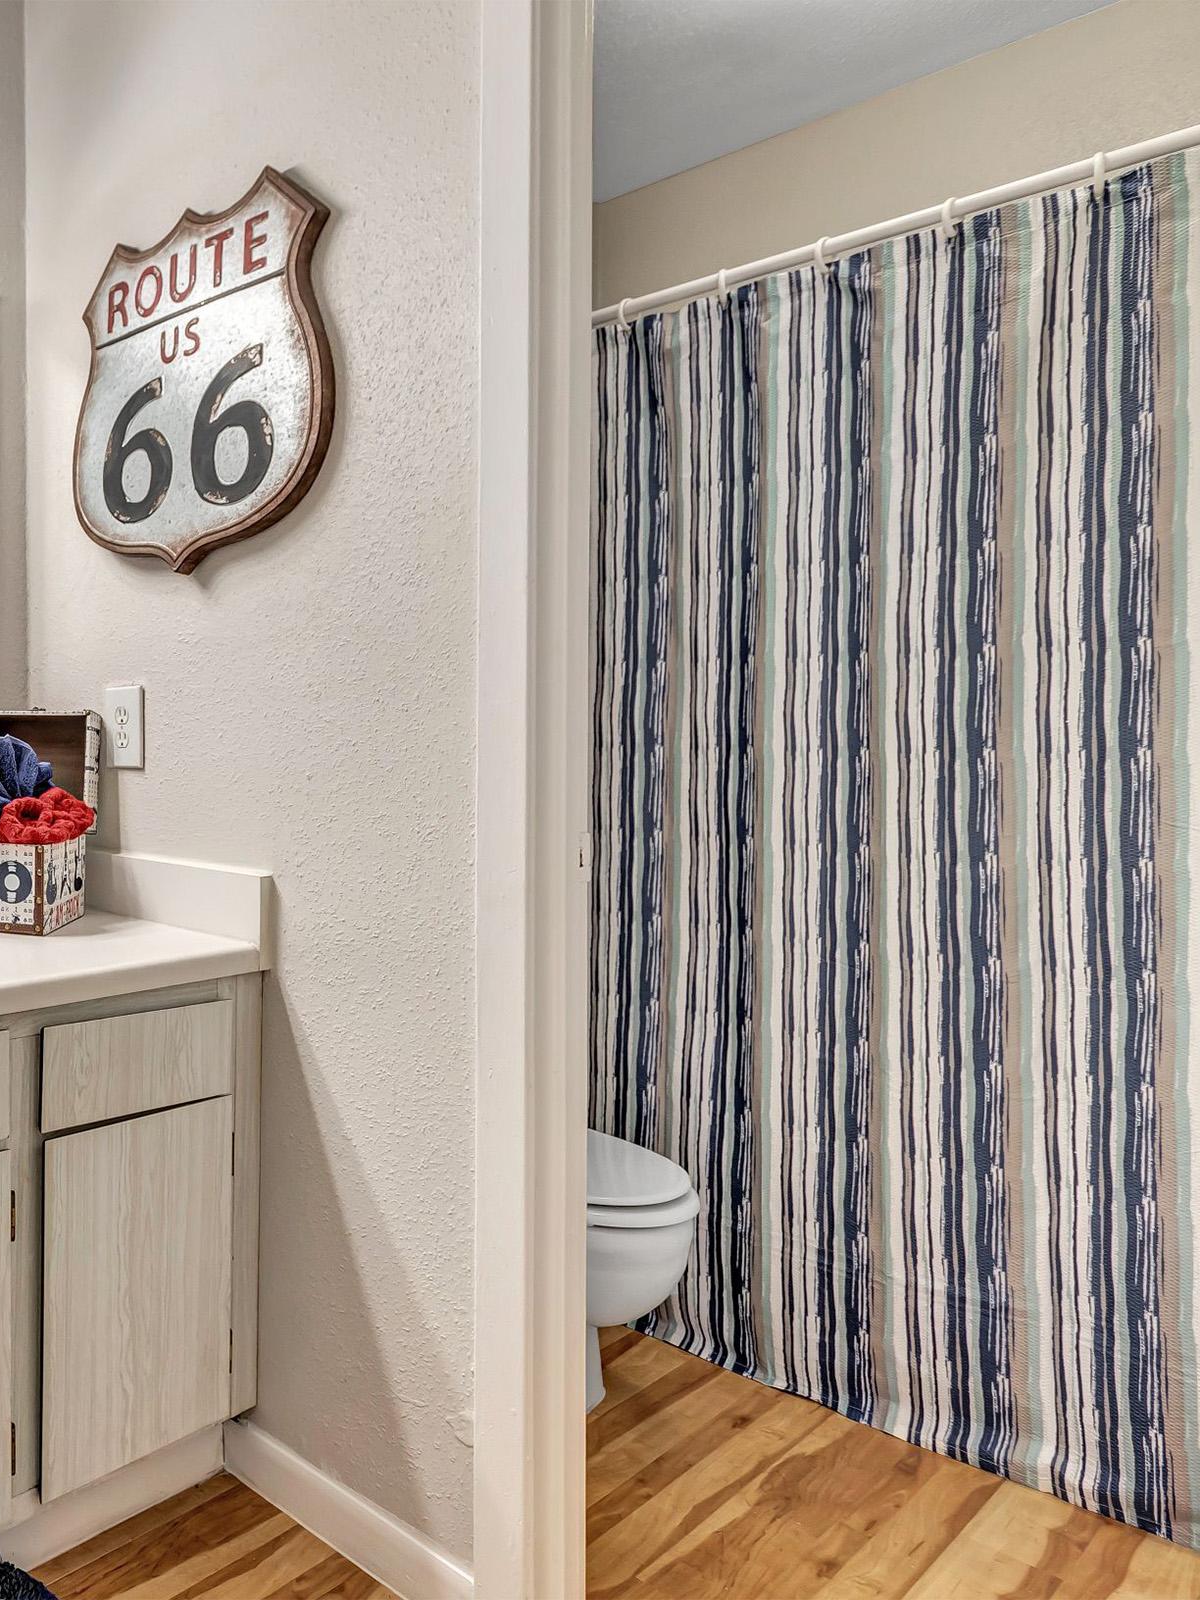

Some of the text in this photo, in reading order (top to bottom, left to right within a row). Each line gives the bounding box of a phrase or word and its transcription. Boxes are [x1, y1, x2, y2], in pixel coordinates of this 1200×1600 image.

[106, 210, 269, 335] ROUTE
[160, 317, 201, 364] US
[102, 342, 274, 524] 66
